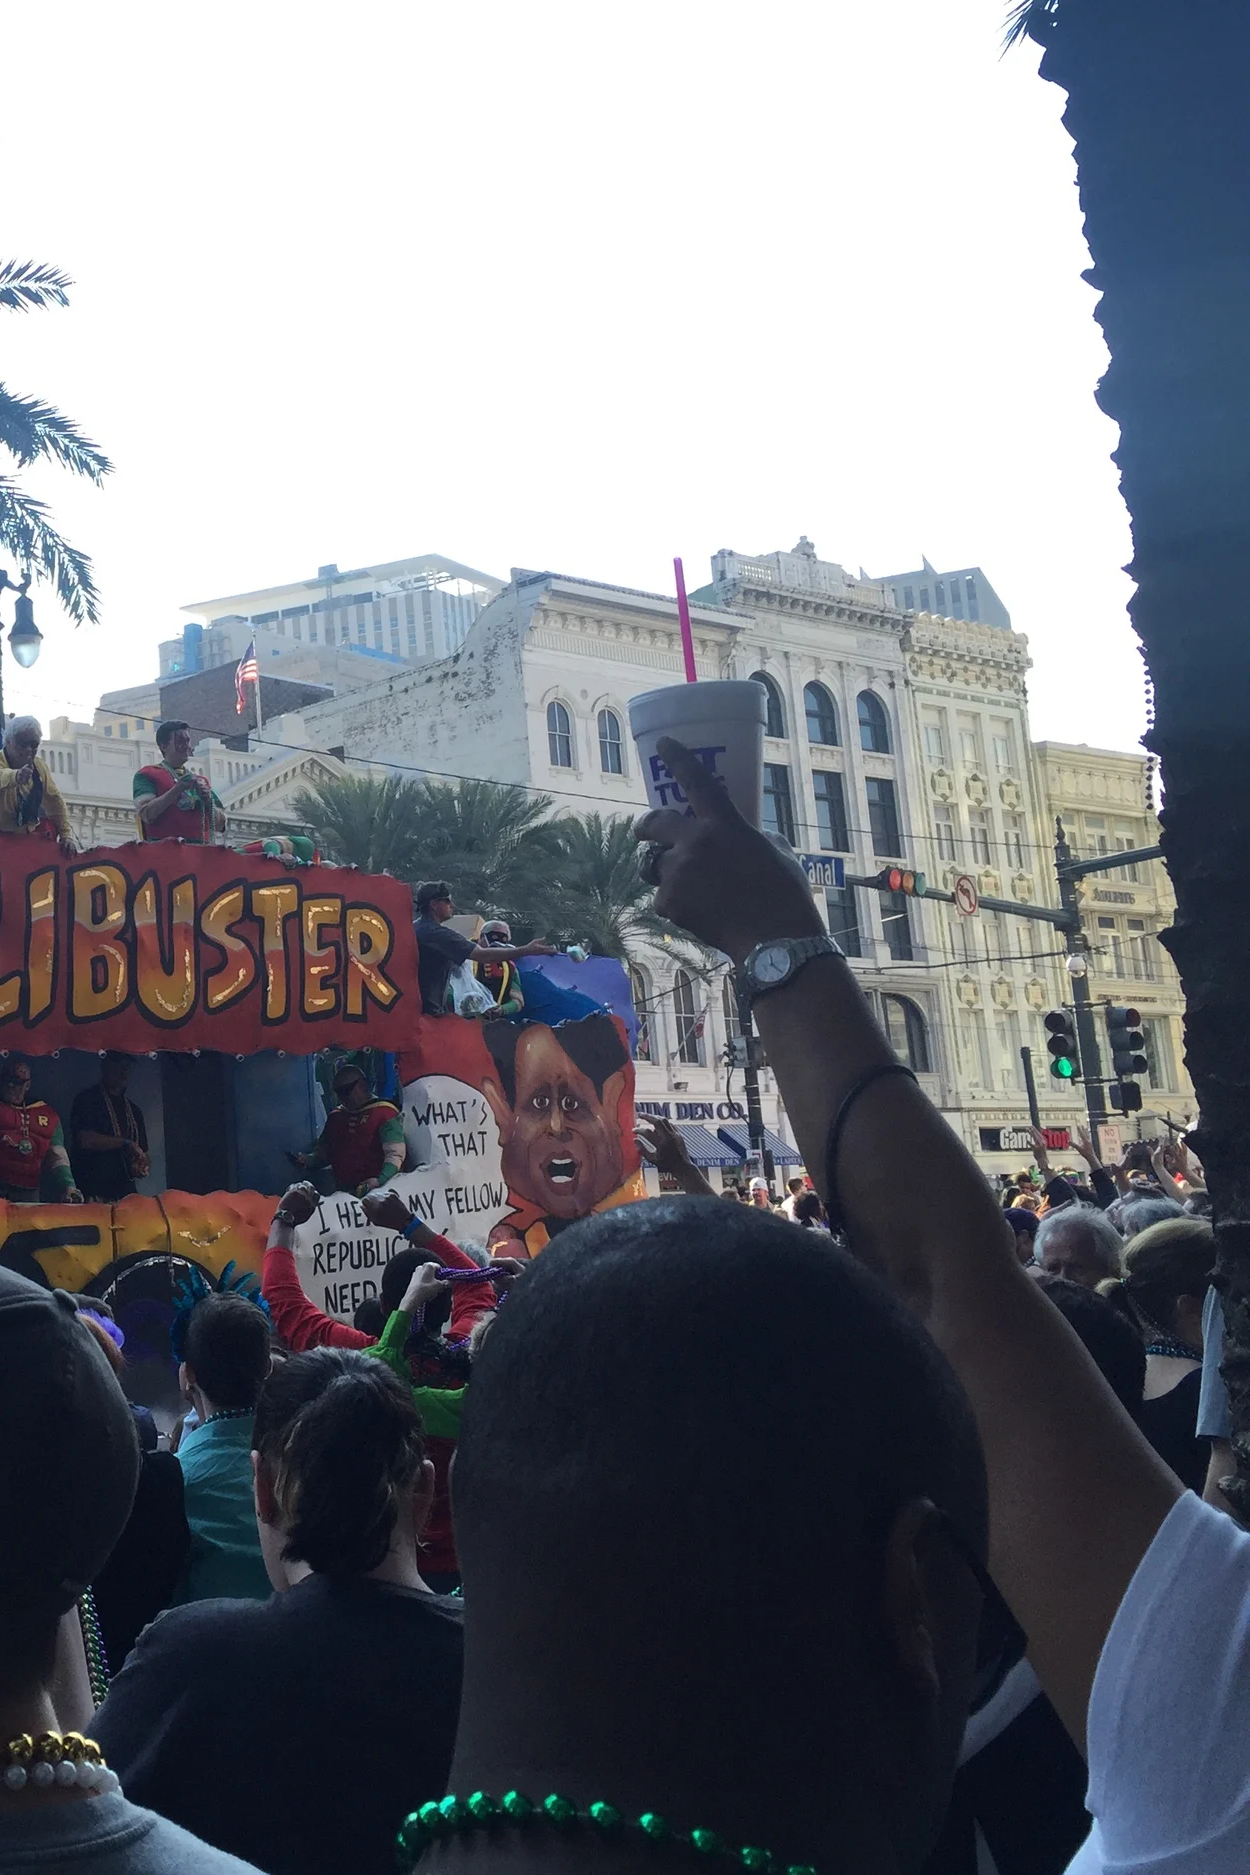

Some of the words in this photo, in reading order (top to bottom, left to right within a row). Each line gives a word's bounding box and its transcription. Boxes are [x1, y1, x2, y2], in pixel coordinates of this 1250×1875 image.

[411, 1098, 488, 1127] WHAT'S
[635, 1102, 672, 1120] NIM
[676, 1102, 714, 1120] DEN
[438, 1131, 488, 1157] THAT
[1000, 1129, 1070, 1150] GamStop
[1104, 1128, 1115, 1137] NO
[317, 1201, 331, 1236] I
[409, 1190, 435, 1220] MY
[445, 1182, 503, 1216] FELLOW
[313, 1236, 414, 1276] REPUBLIC
